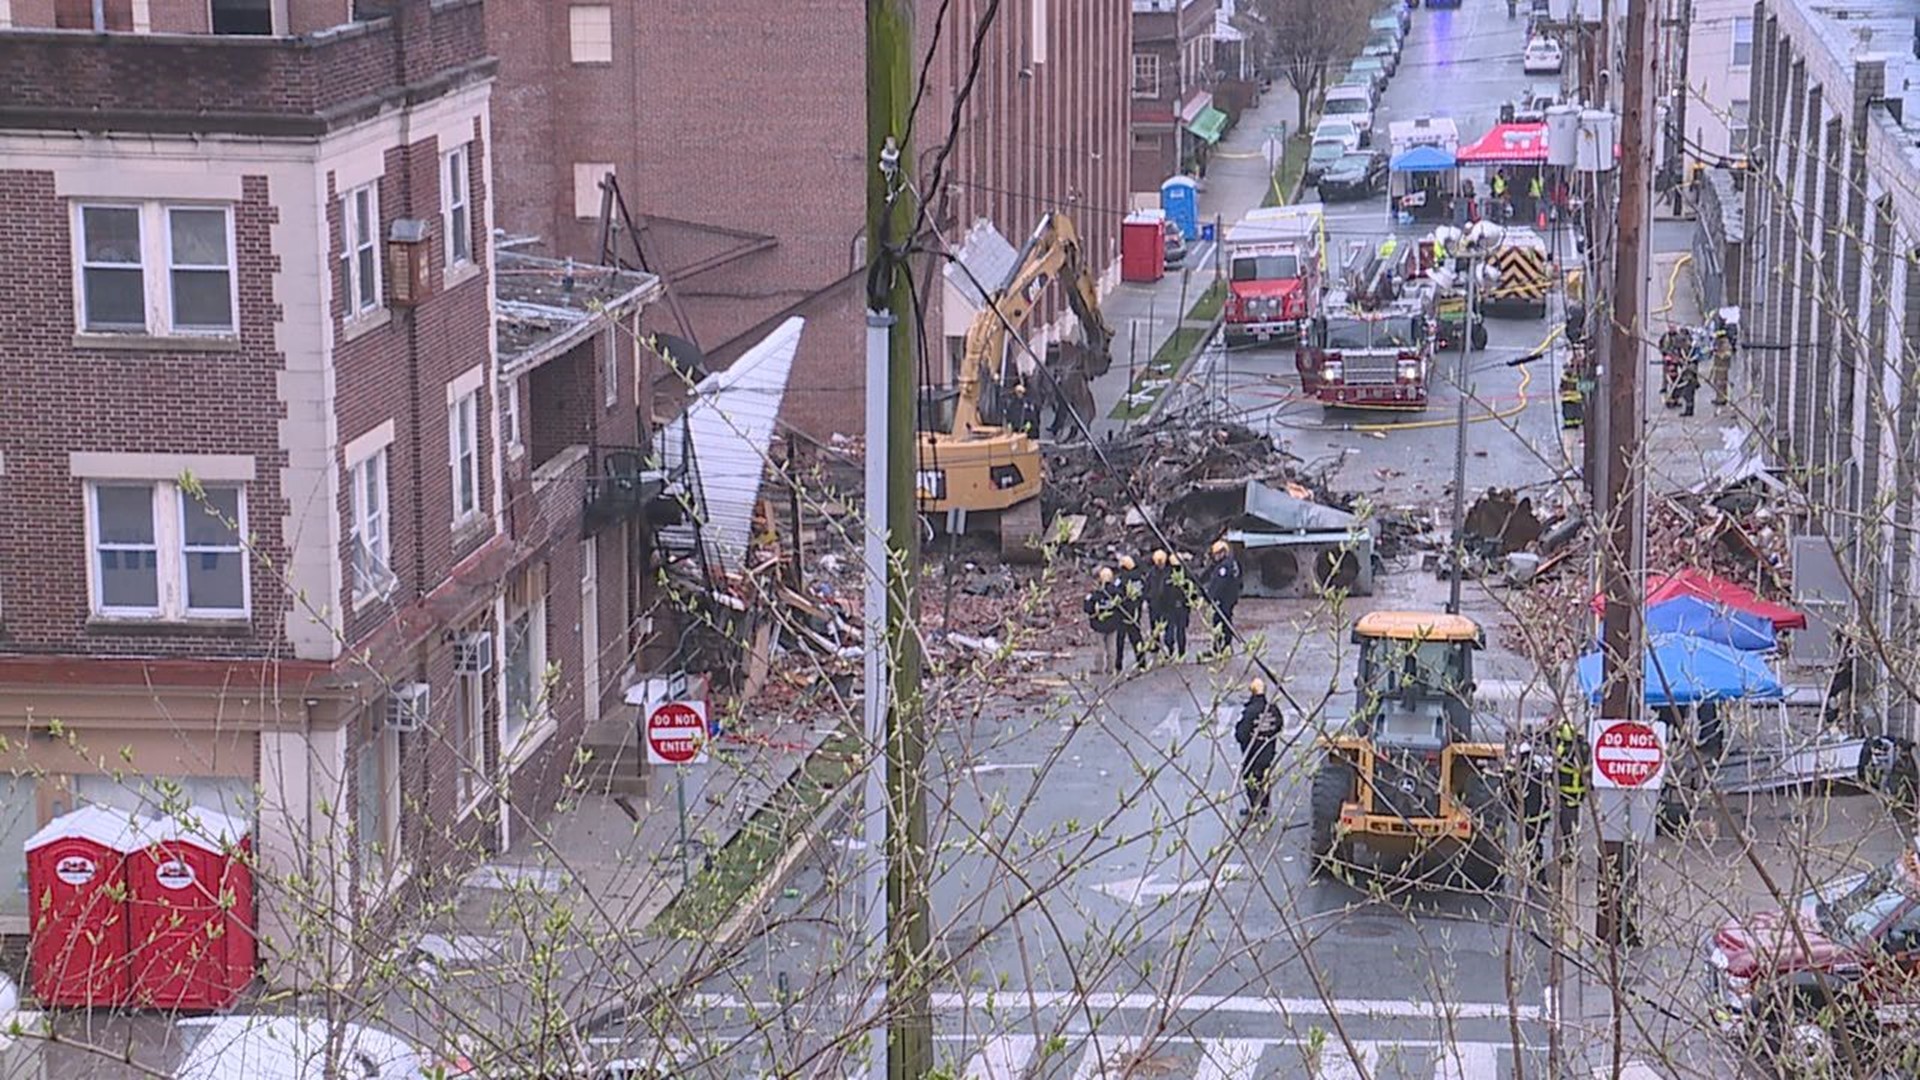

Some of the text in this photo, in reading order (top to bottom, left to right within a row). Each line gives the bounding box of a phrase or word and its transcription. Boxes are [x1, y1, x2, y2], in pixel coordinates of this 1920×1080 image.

[654, 714, 696, 726] DO NOT
[1604, 733, 1654, 746] DO NOT
[1608, 762, 1649, 776] ENTER
